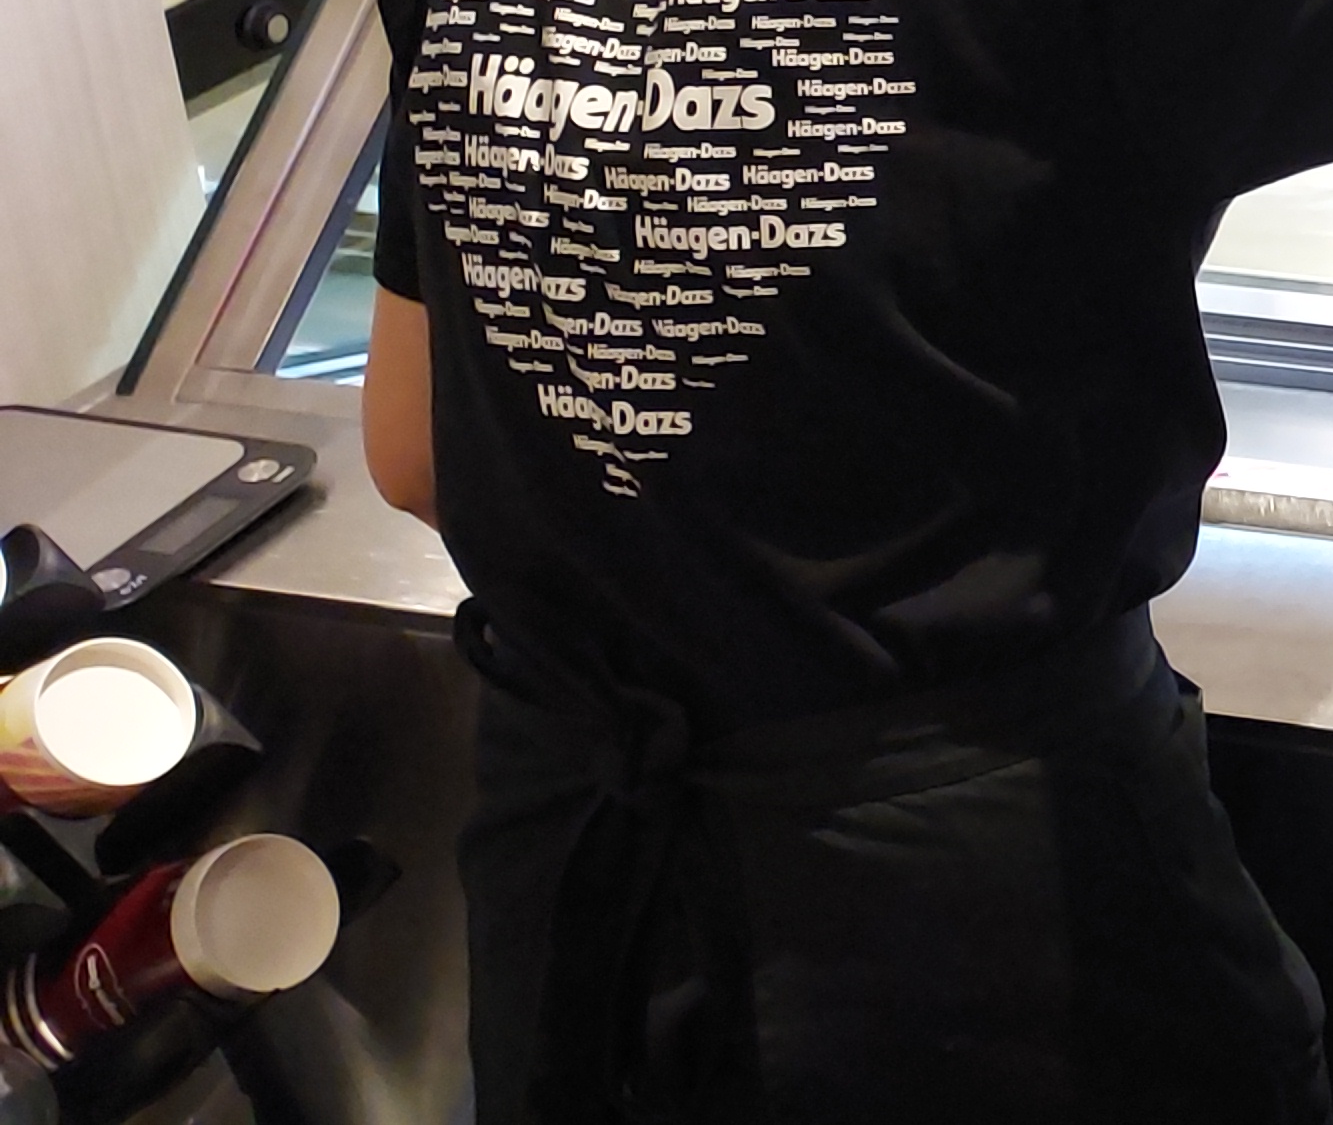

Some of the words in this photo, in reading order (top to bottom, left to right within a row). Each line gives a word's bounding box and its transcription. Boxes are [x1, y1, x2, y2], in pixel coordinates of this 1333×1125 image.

[772, 48, 894, 70] Häagen-Dazs
[469, 54, 775, 141] Häagen-Dazs
[798, 78, 916, 100] Häagen-Dazs
[788, 118, 906, 140] Häagen-Dazs
[743, 162, 874, 188] Häagen-Dazs
[636, 215, 846, 260] Häagen-Dazs
